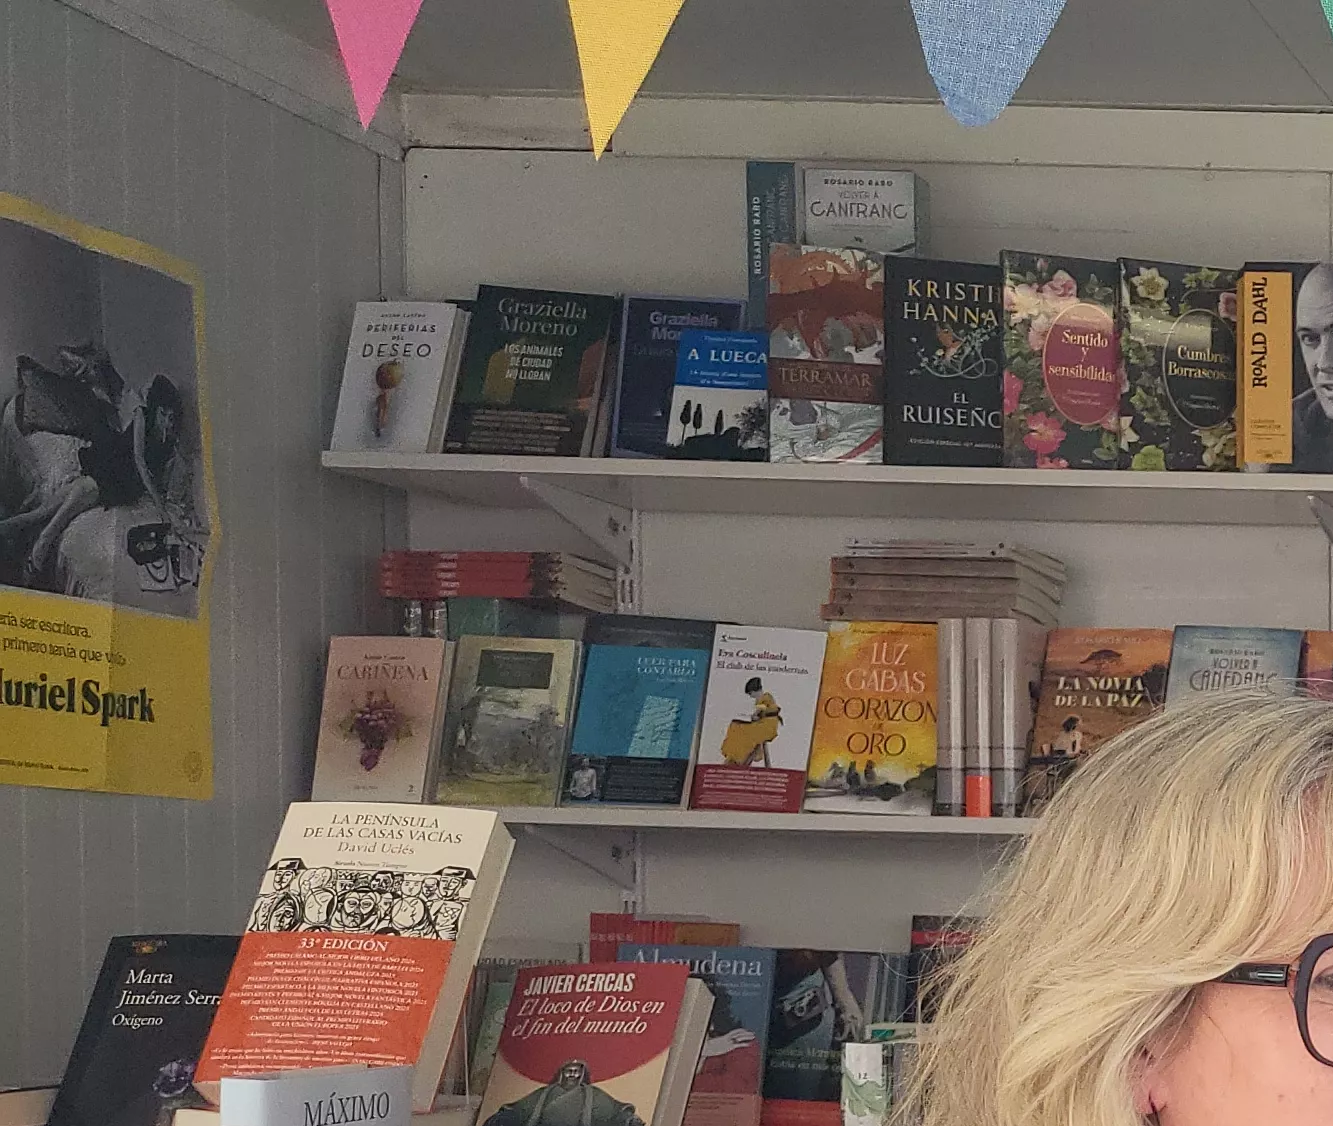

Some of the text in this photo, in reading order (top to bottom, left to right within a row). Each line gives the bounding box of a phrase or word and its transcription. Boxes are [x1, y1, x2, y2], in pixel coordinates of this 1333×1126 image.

[810, 200, 908, 219] CANFRANC
[908, 279, 1000, 303] KRISTI
[498, 297, 588, 319] Graziella
[903, 302, 998, 326] HANNA
[366, 324, 436, 333] PERIFERIAS
[501, 315, 578, 337] Moreno
[649, 311, 718, 327] Graziella
[1062, 329, 1109, 348] Sentido
[1251, 277, 1267, 388] ROALD DAHL
[362, 343, 431, 358] DESEO
[504, 343, 564, 357] LOS ANIMALES
[687, 349, 700, 361] A
[709, 349, 768, 364] LUECA
[1081, 347, 1089, 362] y
[522, 358, 552, 369] CIUDAD
[780, 367, 874, 387] TERRAMAR
[1048, 365, 1114, 383] sensibilida
[953, 392, 969, 404] EL
[903, 405, 1002, 429] RUISEÑO
[3, 637, 103, 662] primero tenía que
[870, 642, 909, 666] LUZ
[336, 663, 428, 682] CARIÑENA
[1057, 676, 1144, 691] LA NOVIA
[82, 679, 155, 727] Spark
[1054, 694, 1143, 708] DE LA PAZ
[847, 732, 906, 757] ORO
[331, 813, 439, 829] LA PENÍNSULA
[303, 827, 463, 844] DE LAS CASAS VACÍAS
[337, 841, 415, 855] David Uclés
[322, 938, 389, 952] EDICIÓN
[126, 968, 173, 984] Marta
[524, 973, 635, 996] JAVIER CERCAS
[115, 989, 181, 1009] Jiménez
[517, 996, 665, 1016] El loco de Dios en
[112, 1013, 163, 1030] Oxígeno
[512, 1016, 647, 1040] el fin del mundo
